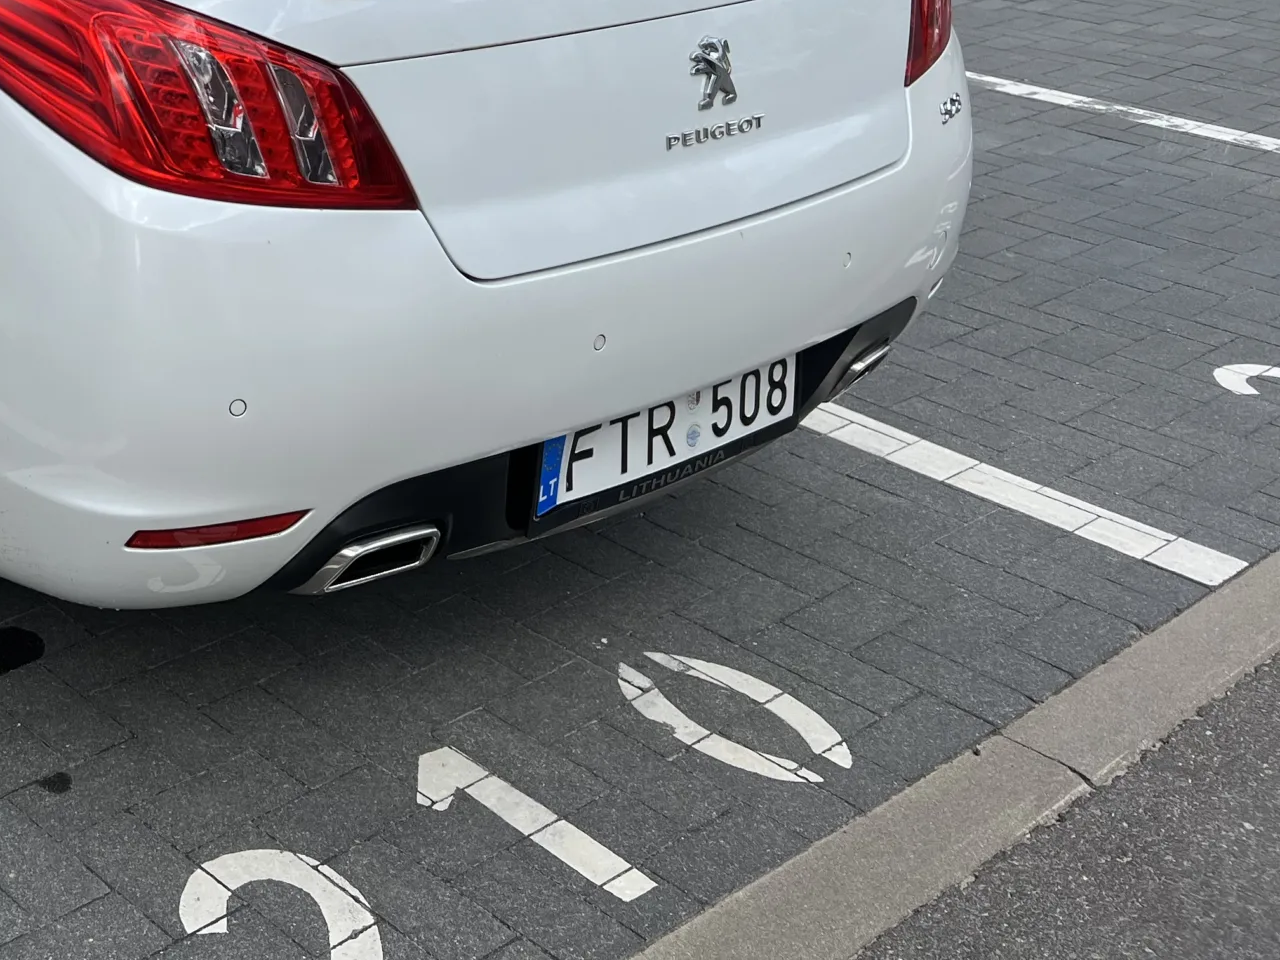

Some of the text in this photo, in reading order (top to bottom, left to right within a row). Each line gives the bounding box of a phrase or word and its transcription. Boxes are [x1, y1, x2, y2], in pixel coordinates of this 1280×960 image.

[665, 113, 766, 151] PEUGEOT
[566, 357, 788, 492] FTR 508
[538, 477, 558, 503] LT
[619, 449, 726, 502] LITHUANIA
